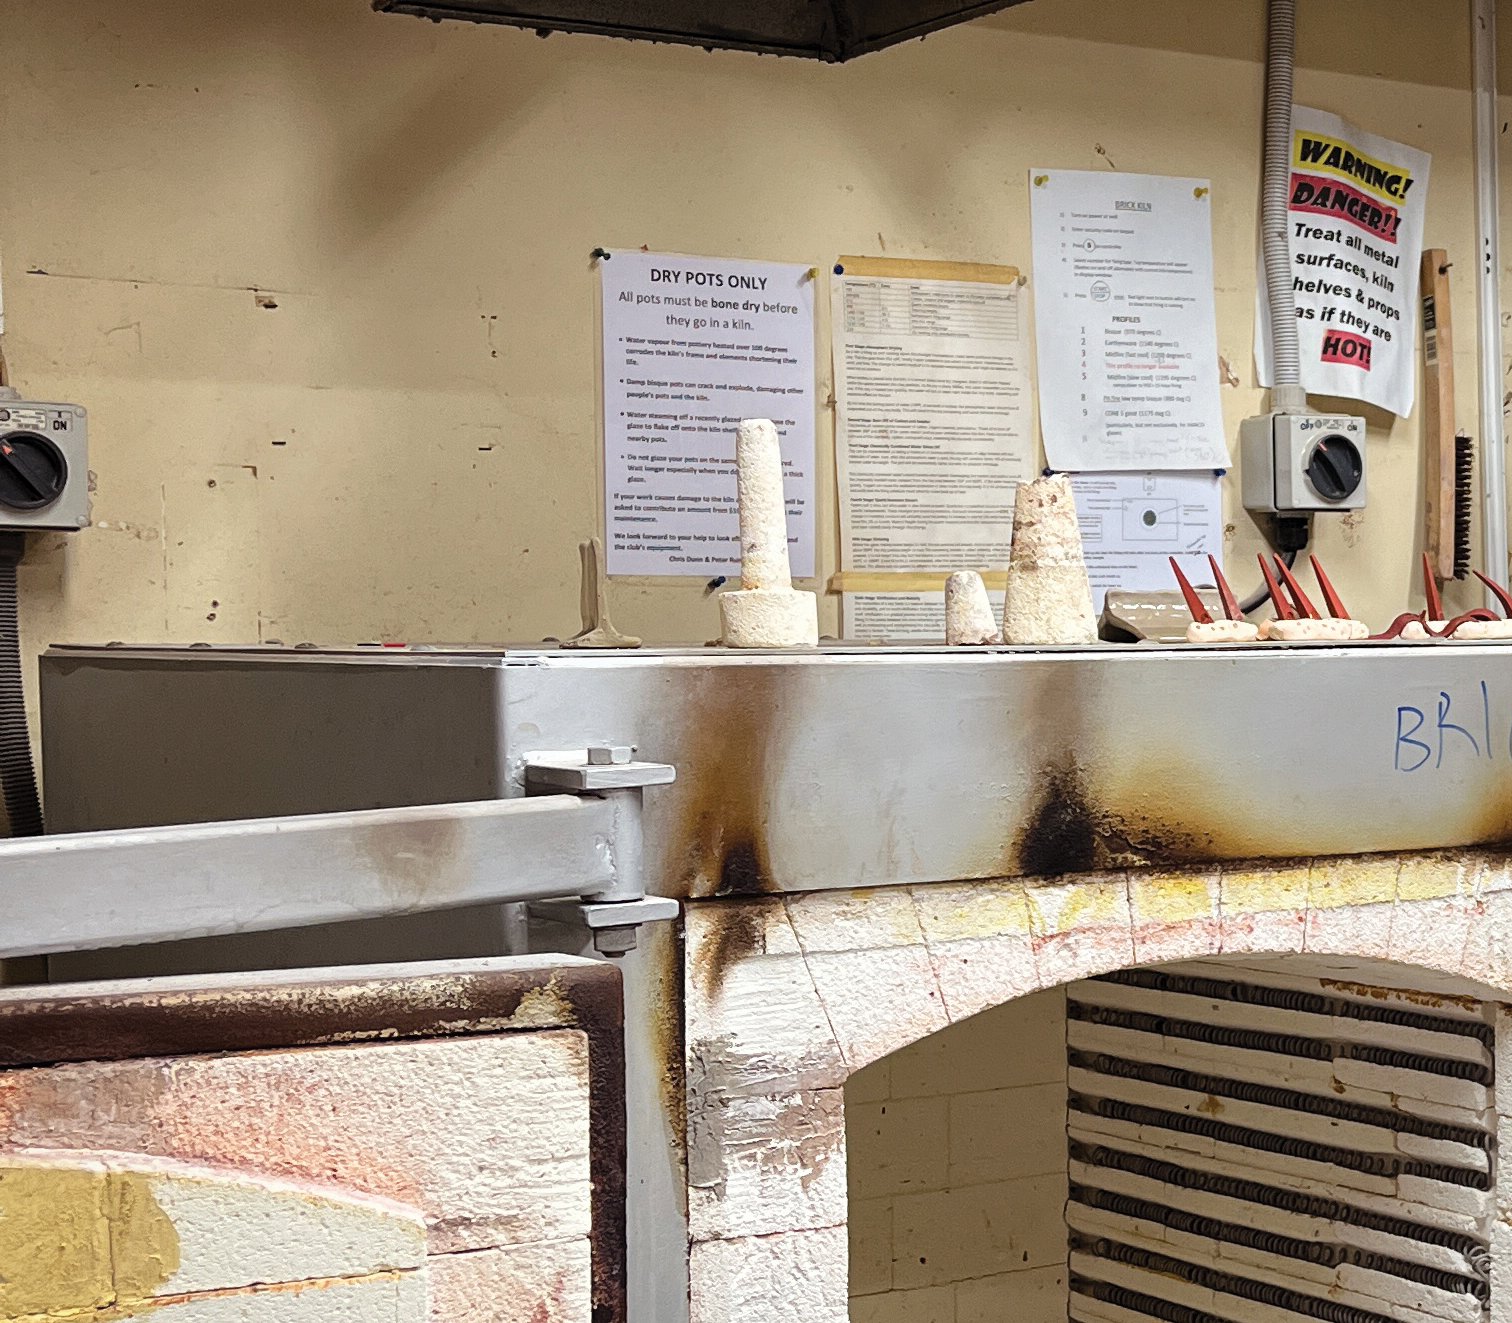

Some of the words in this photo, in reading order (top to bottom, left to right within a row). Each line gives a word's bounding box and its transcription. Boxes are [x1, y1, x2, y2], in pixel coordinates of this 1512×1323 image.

[1300, 138, 1414, 199] WARNING!
[1291, 181, 1402, 236] DANGER!!
[1295, 222, 1342, 243] Treat
[1345, 236, 1361, 251] all
[1364, 243, 1400, 268] metal
[650, 268, 681, 283] DRY
[686, 271, 724, 287] POTS
[728, 275, 768, 290] ONLY
[1295, 252, 1369, 283] surfaces,
[1372, 271, 1394, 293] kiln
[619, 291, 633, 302] All
[636, 293, 661, 305] pots
[664, 296, 692, 307] must
[694, 296, 708, 308] be
[711, 298, 739, 310] bone
[742, 300, 761, 313] dry
[763, 302, 798, 315] before
[1292, 276, 1352, 298] helves
[1355, 288, 1365, 304] &
[1367, 296, 1400, 321] props
[666, 314, 691, 328] they
[693, 318, 707, 329] go
[709, 316, 719, 328] in
[723, 320, 729, 328] a
[732, 318, 754, 331] kiln.
[1295, 306, 1315, 319] as
[1320, 306, 1337, 322] if
[1339, 309, 1370, 334] they
[1372, 325, 1392, 342] are
[1321, 336, 1372, 364] HOT!
